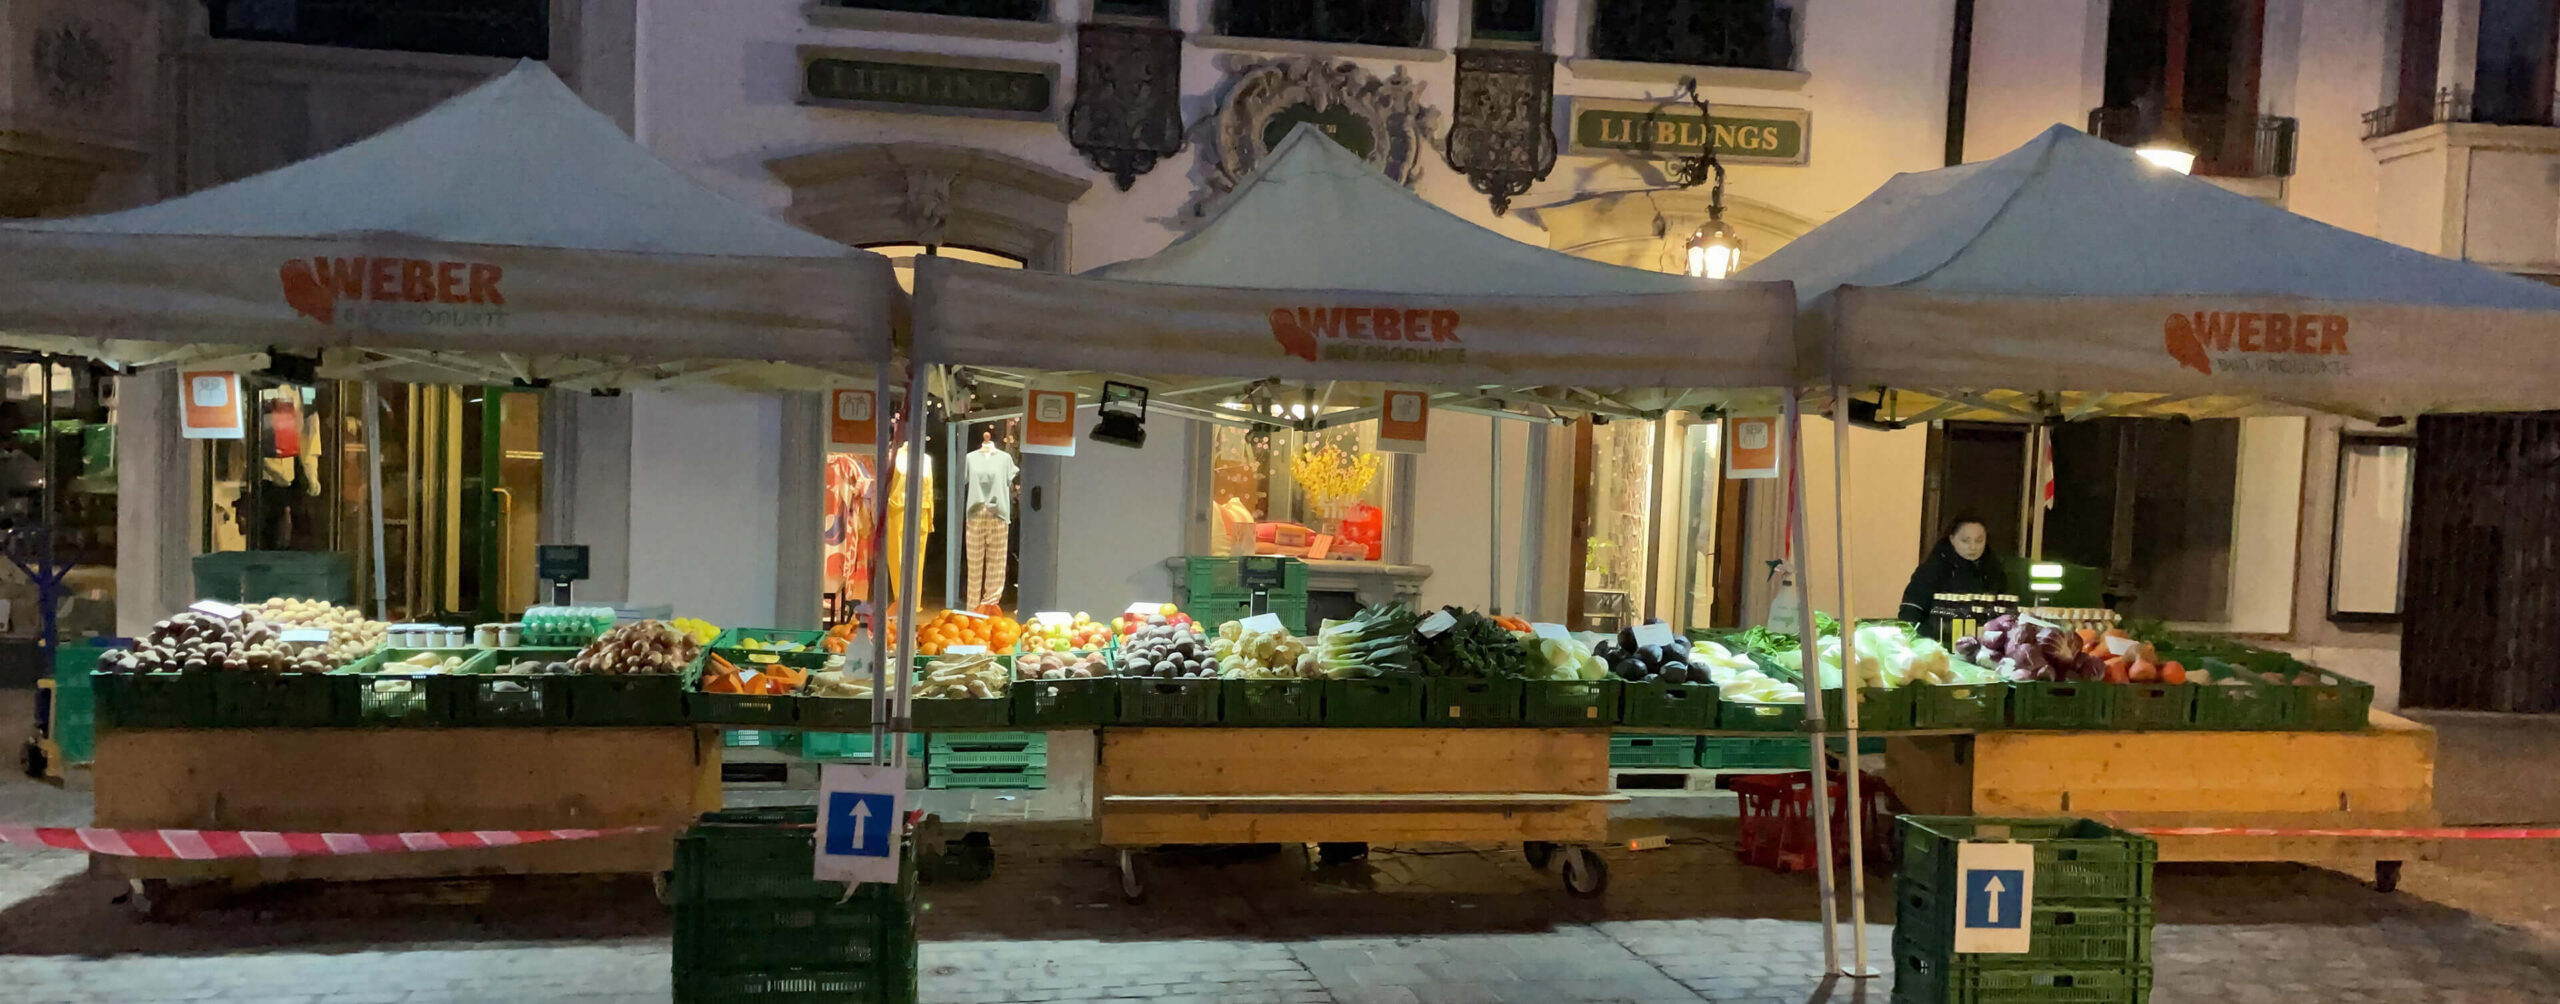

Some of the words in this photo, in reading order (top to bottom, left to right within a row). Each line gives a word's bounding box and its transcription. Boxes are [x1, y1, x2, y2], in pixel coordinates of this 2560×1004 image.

[314, 256, 505, 305] WEBER
[1298, 307, 1462, 343] WEBER
[2194, 311, 2349, 355] WEBER
